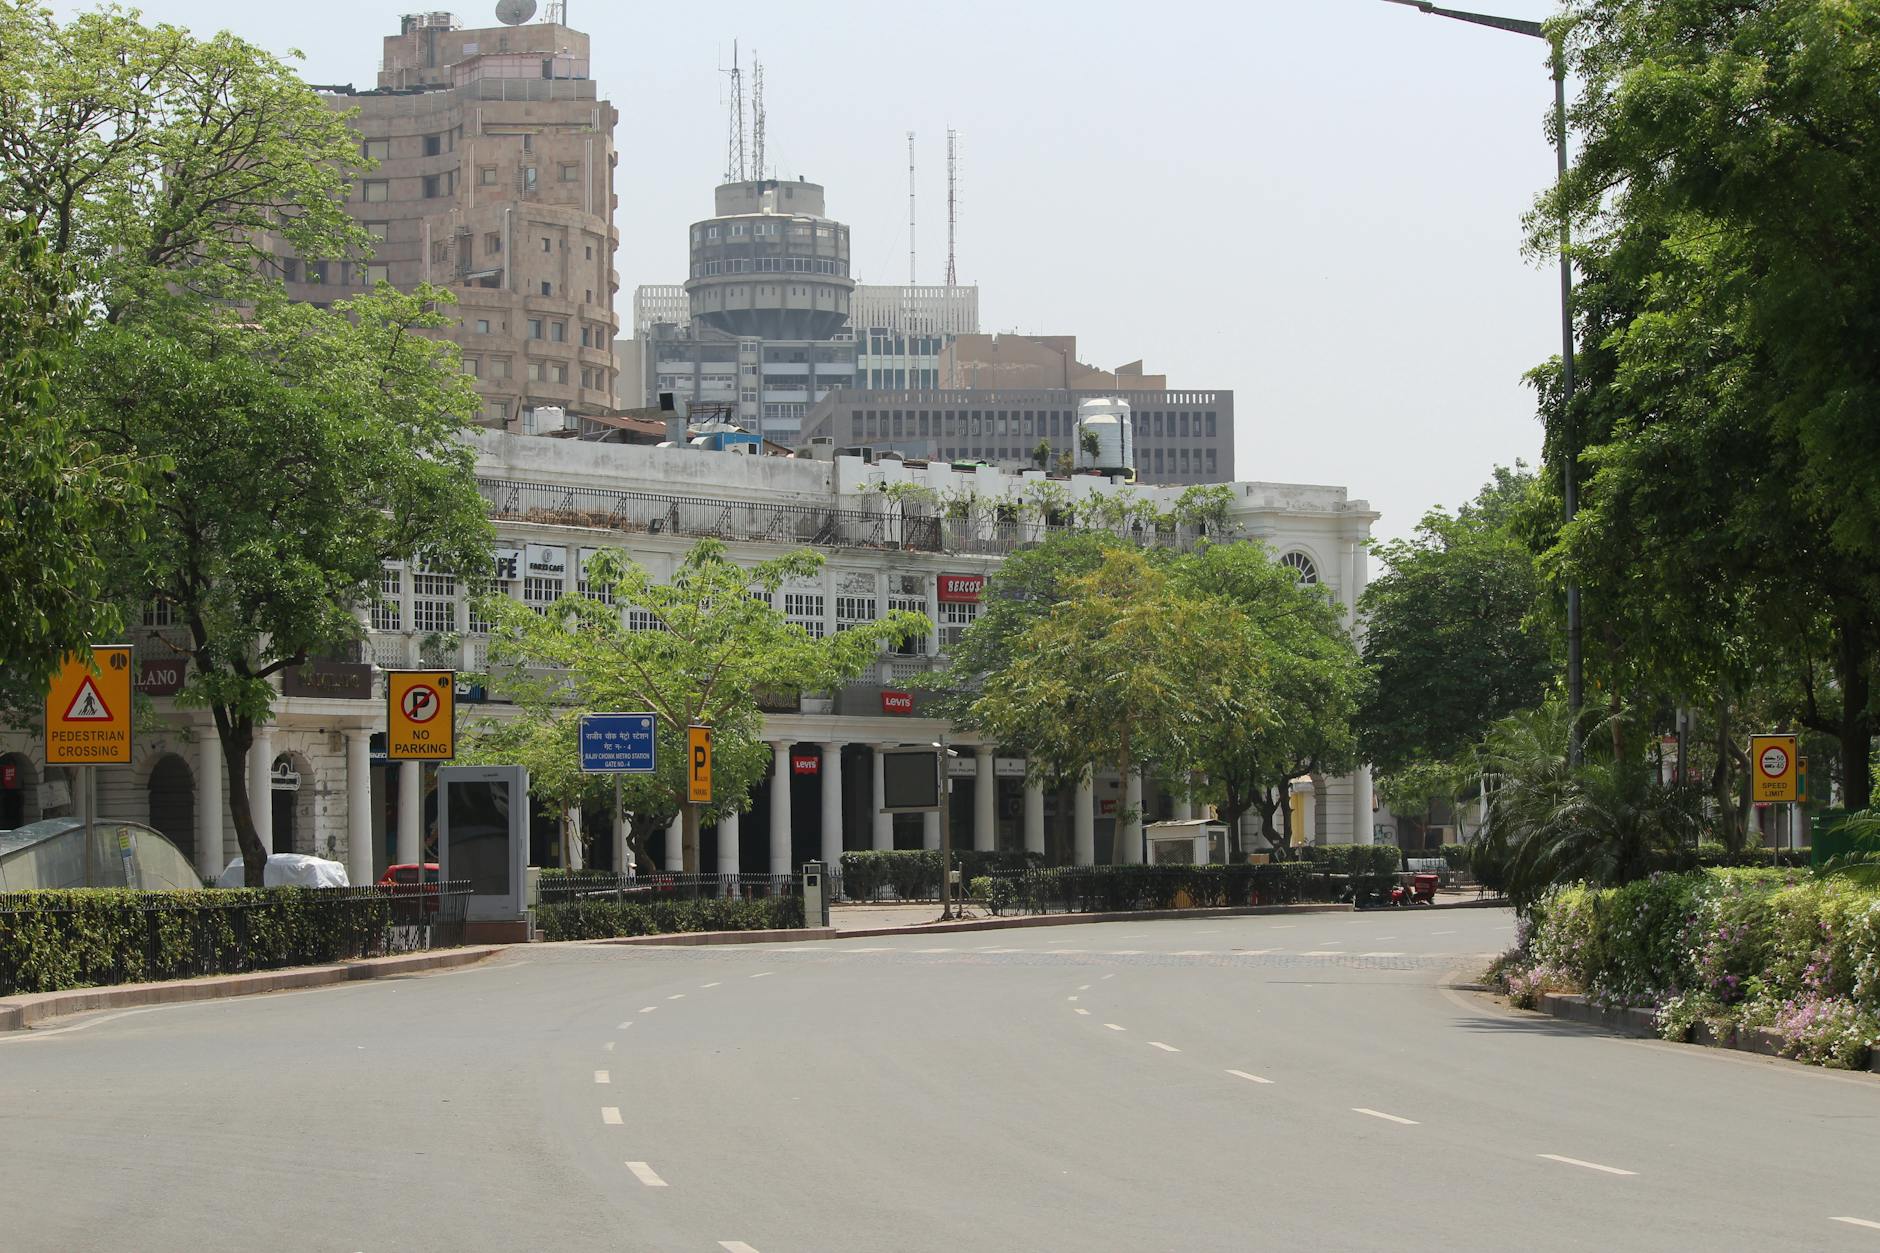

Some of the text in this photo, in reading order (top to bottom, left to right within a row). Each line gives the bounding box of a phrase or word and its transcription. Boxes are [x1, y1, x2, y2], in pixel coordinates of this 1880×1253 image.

[134, 669, 177, 686] LANO
[52, 731, 125, 741] PEDESTRIAN
[413, 730, 429, 740] NO
[58, 746, 118, 756] CROSSING
[395, 744, 447, 753] PARKING
[695, 746, 706, 781] P
